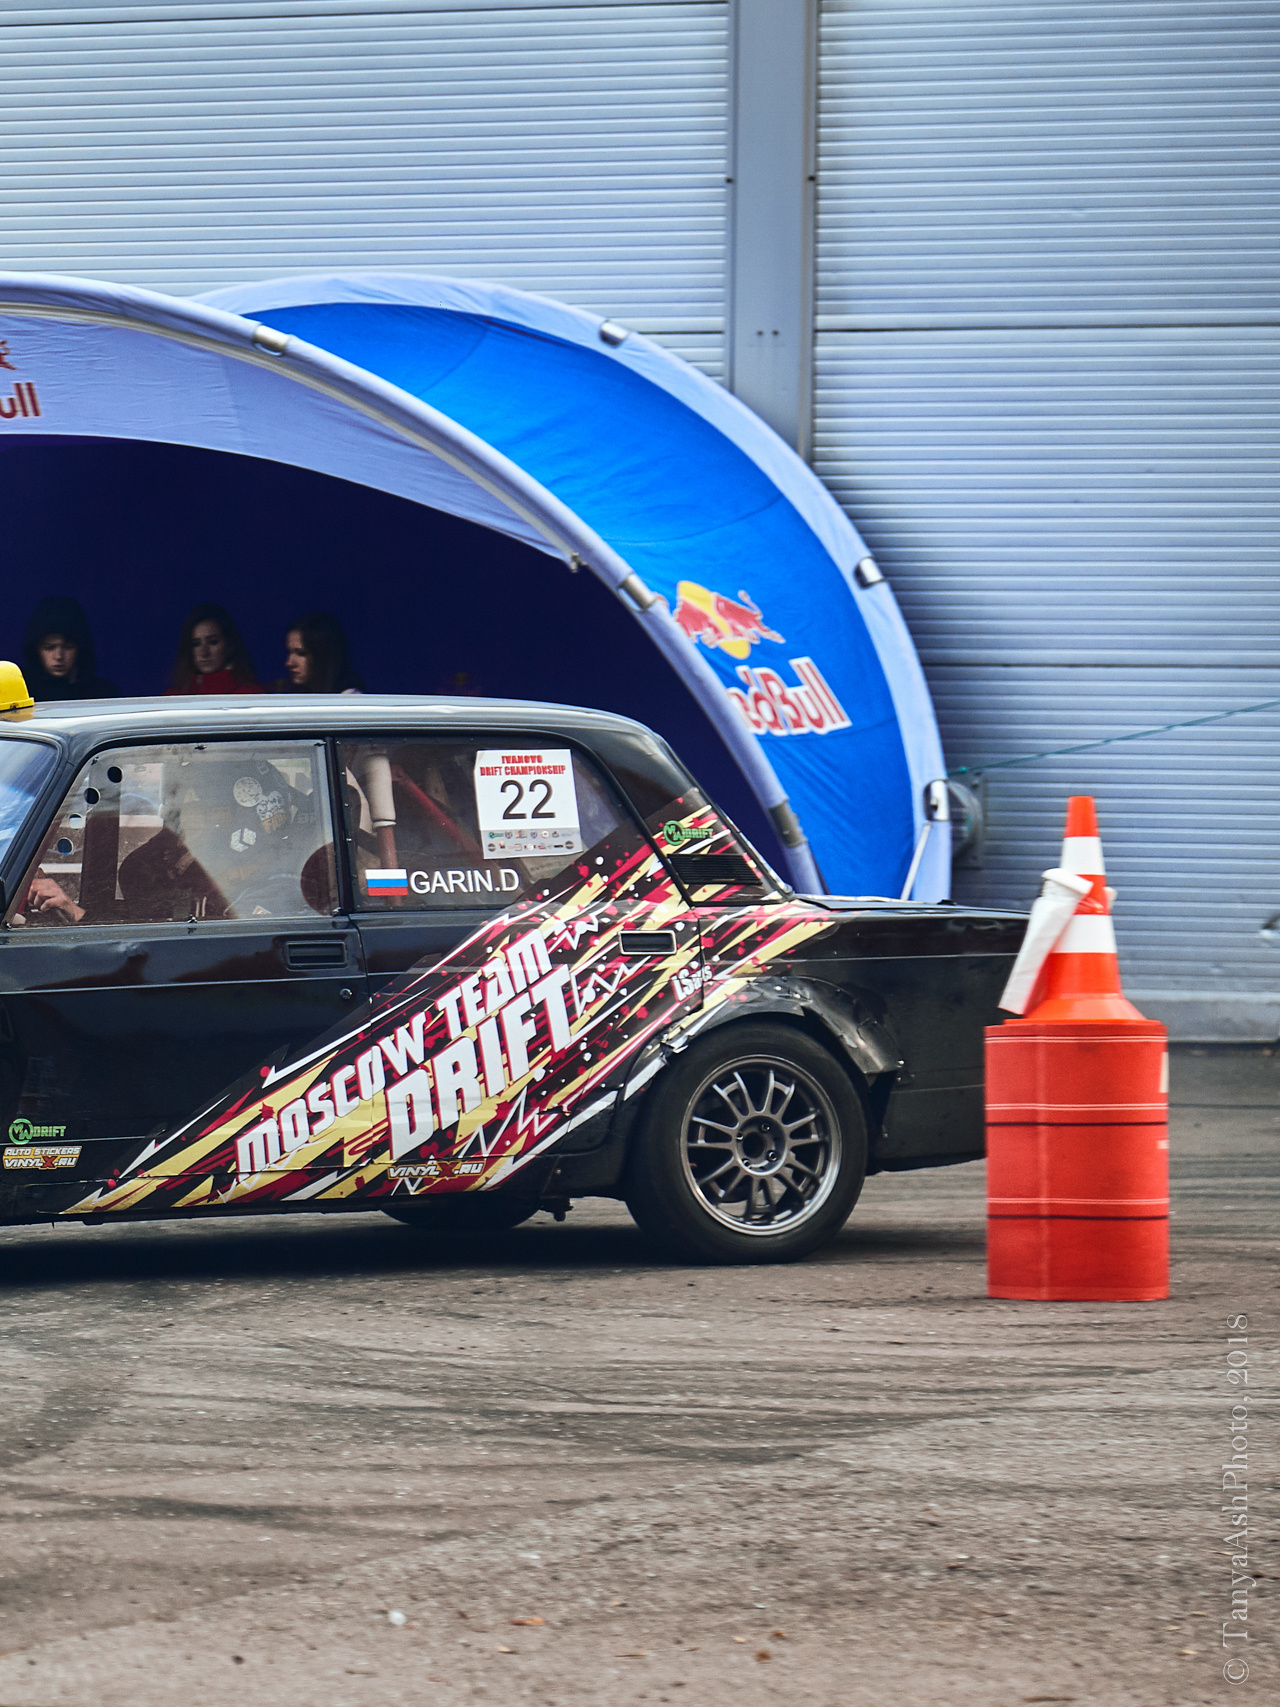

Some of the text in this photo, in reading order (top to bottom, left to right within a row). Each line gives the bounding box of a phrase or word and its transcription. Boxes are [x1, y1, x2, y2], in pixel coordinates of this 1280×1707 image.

[752, 657, 850, 734] Bull
[480, 765, 566, 776] DRIFT CHAMPIONSHIP
[500, 779, 556, 820] 22
[410, 868, 520, 894] GARIN.D
[236, 928, 553, 1184] MOSCOW TEAM
[385, 964, 572, 1161] DRIFT
[32, 1126, 66, 1137] DRIFT
[5, 1147, 80, 1156] AUTO STICKERS
